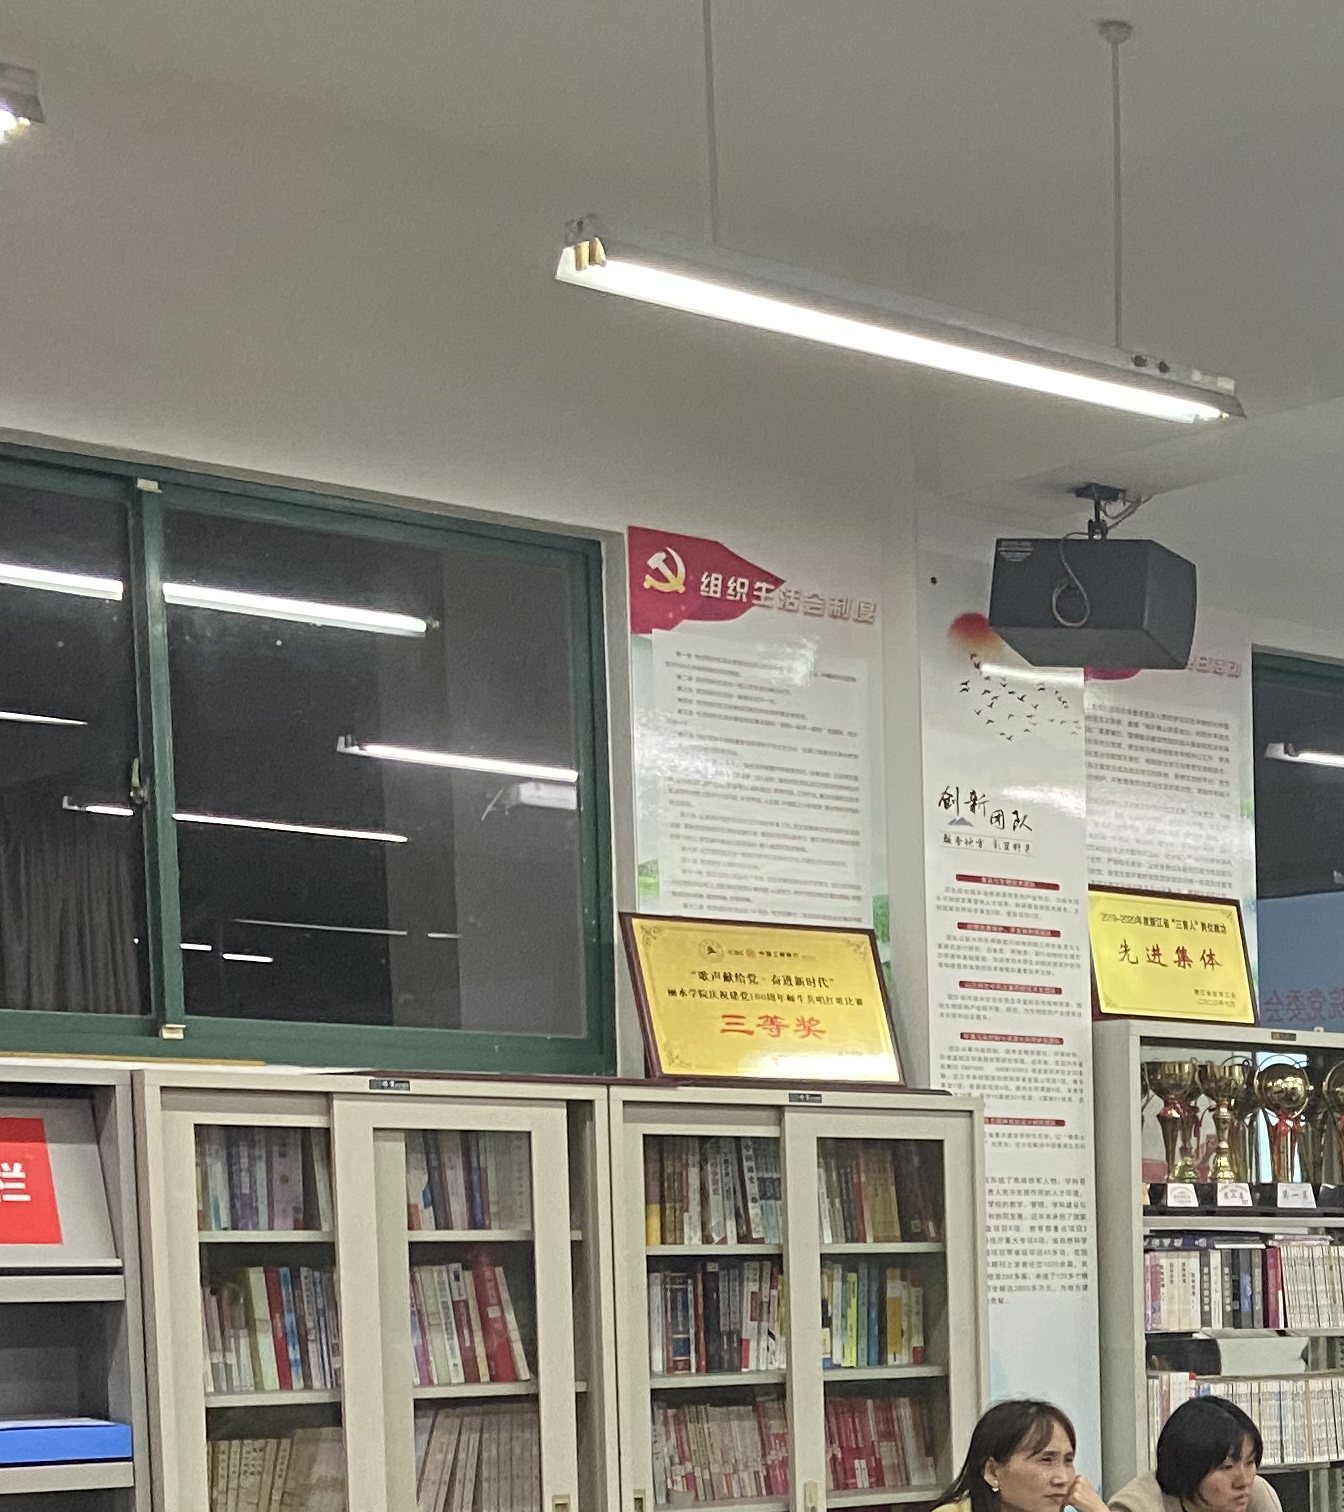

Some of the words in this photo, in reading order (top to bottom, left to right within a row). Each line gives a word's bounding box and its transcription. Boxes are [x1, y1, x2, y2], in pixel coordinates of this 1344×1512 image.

[699, 571, 877, 625] 组织生活会制度
[1118, 938, 1223, 971] 先进集体
[719, 1013, 827, 1040] 三等奖
